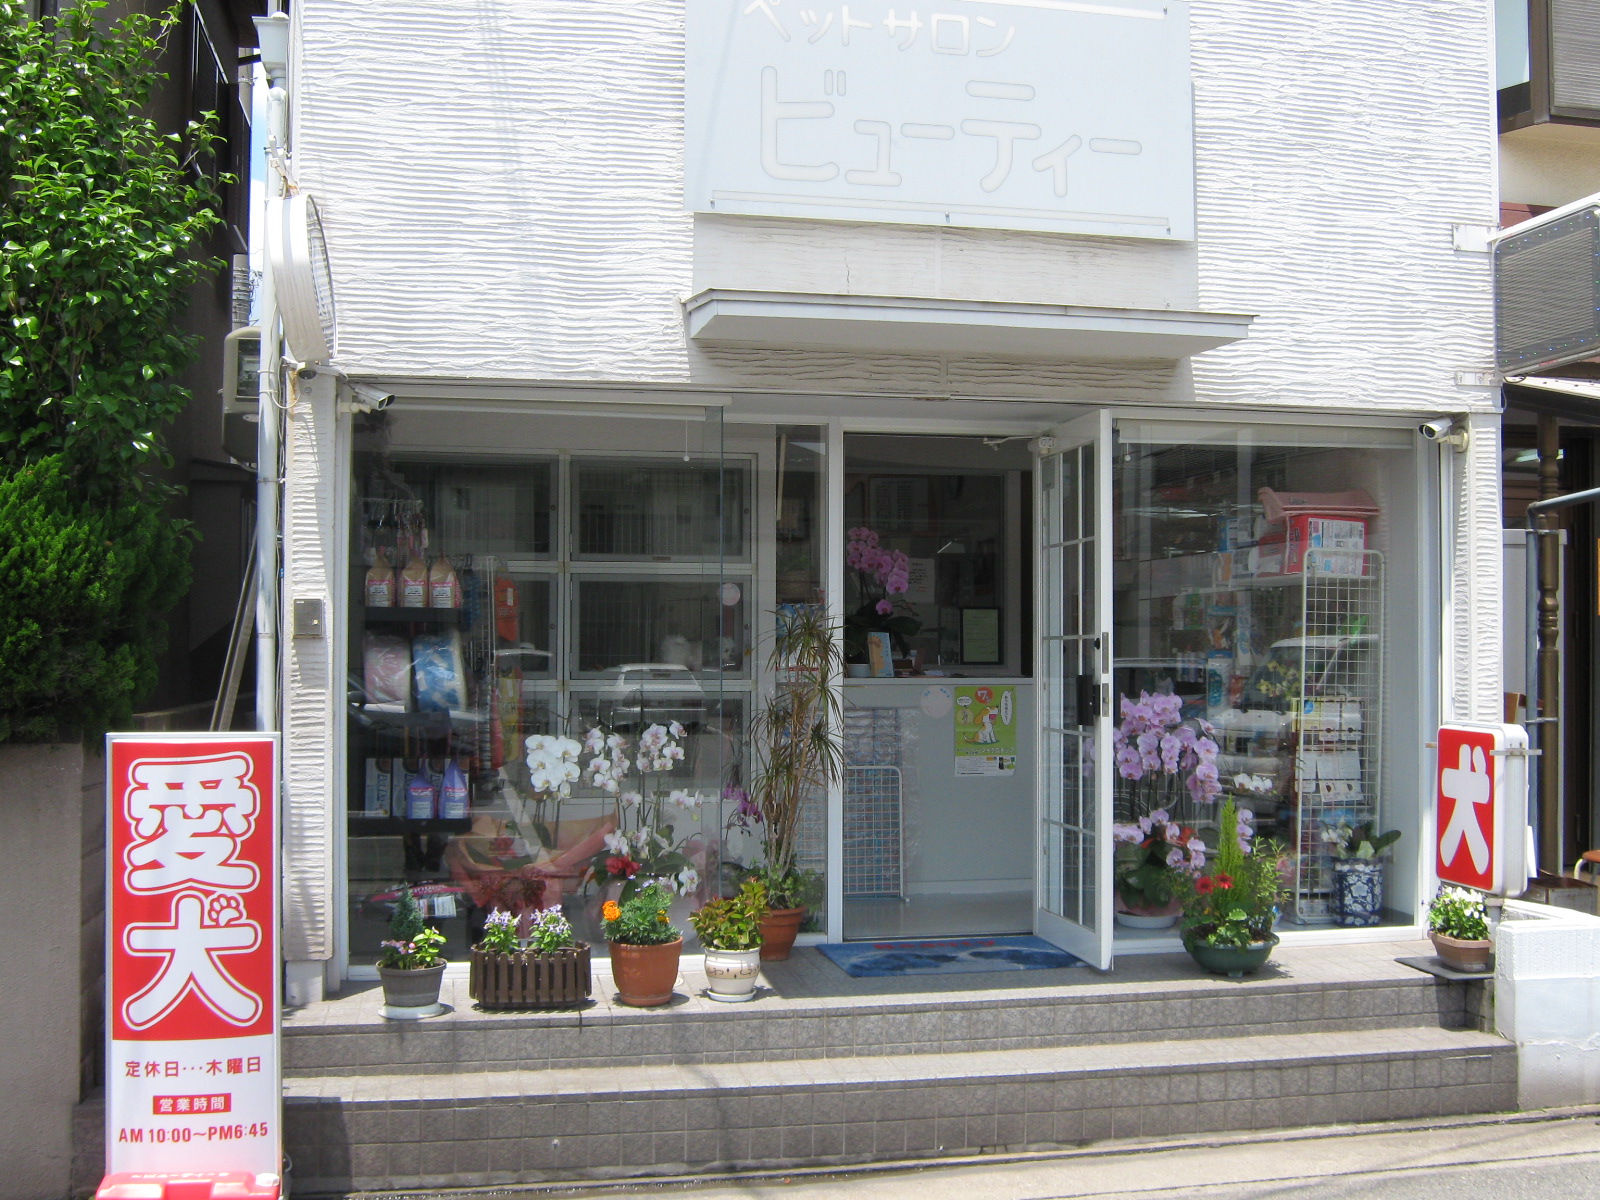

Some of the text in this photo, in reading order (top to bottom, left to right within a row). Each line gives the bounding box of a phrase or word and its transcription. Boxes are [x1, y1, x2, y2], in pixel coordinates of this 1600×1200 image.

[760, 65, 1143, 198] ビューティー
[1440, 743, 1490, 875] 犬
[122, 751, 263, 1031] 愛犬
[159, 1096, 225, 1112] 営業時間
